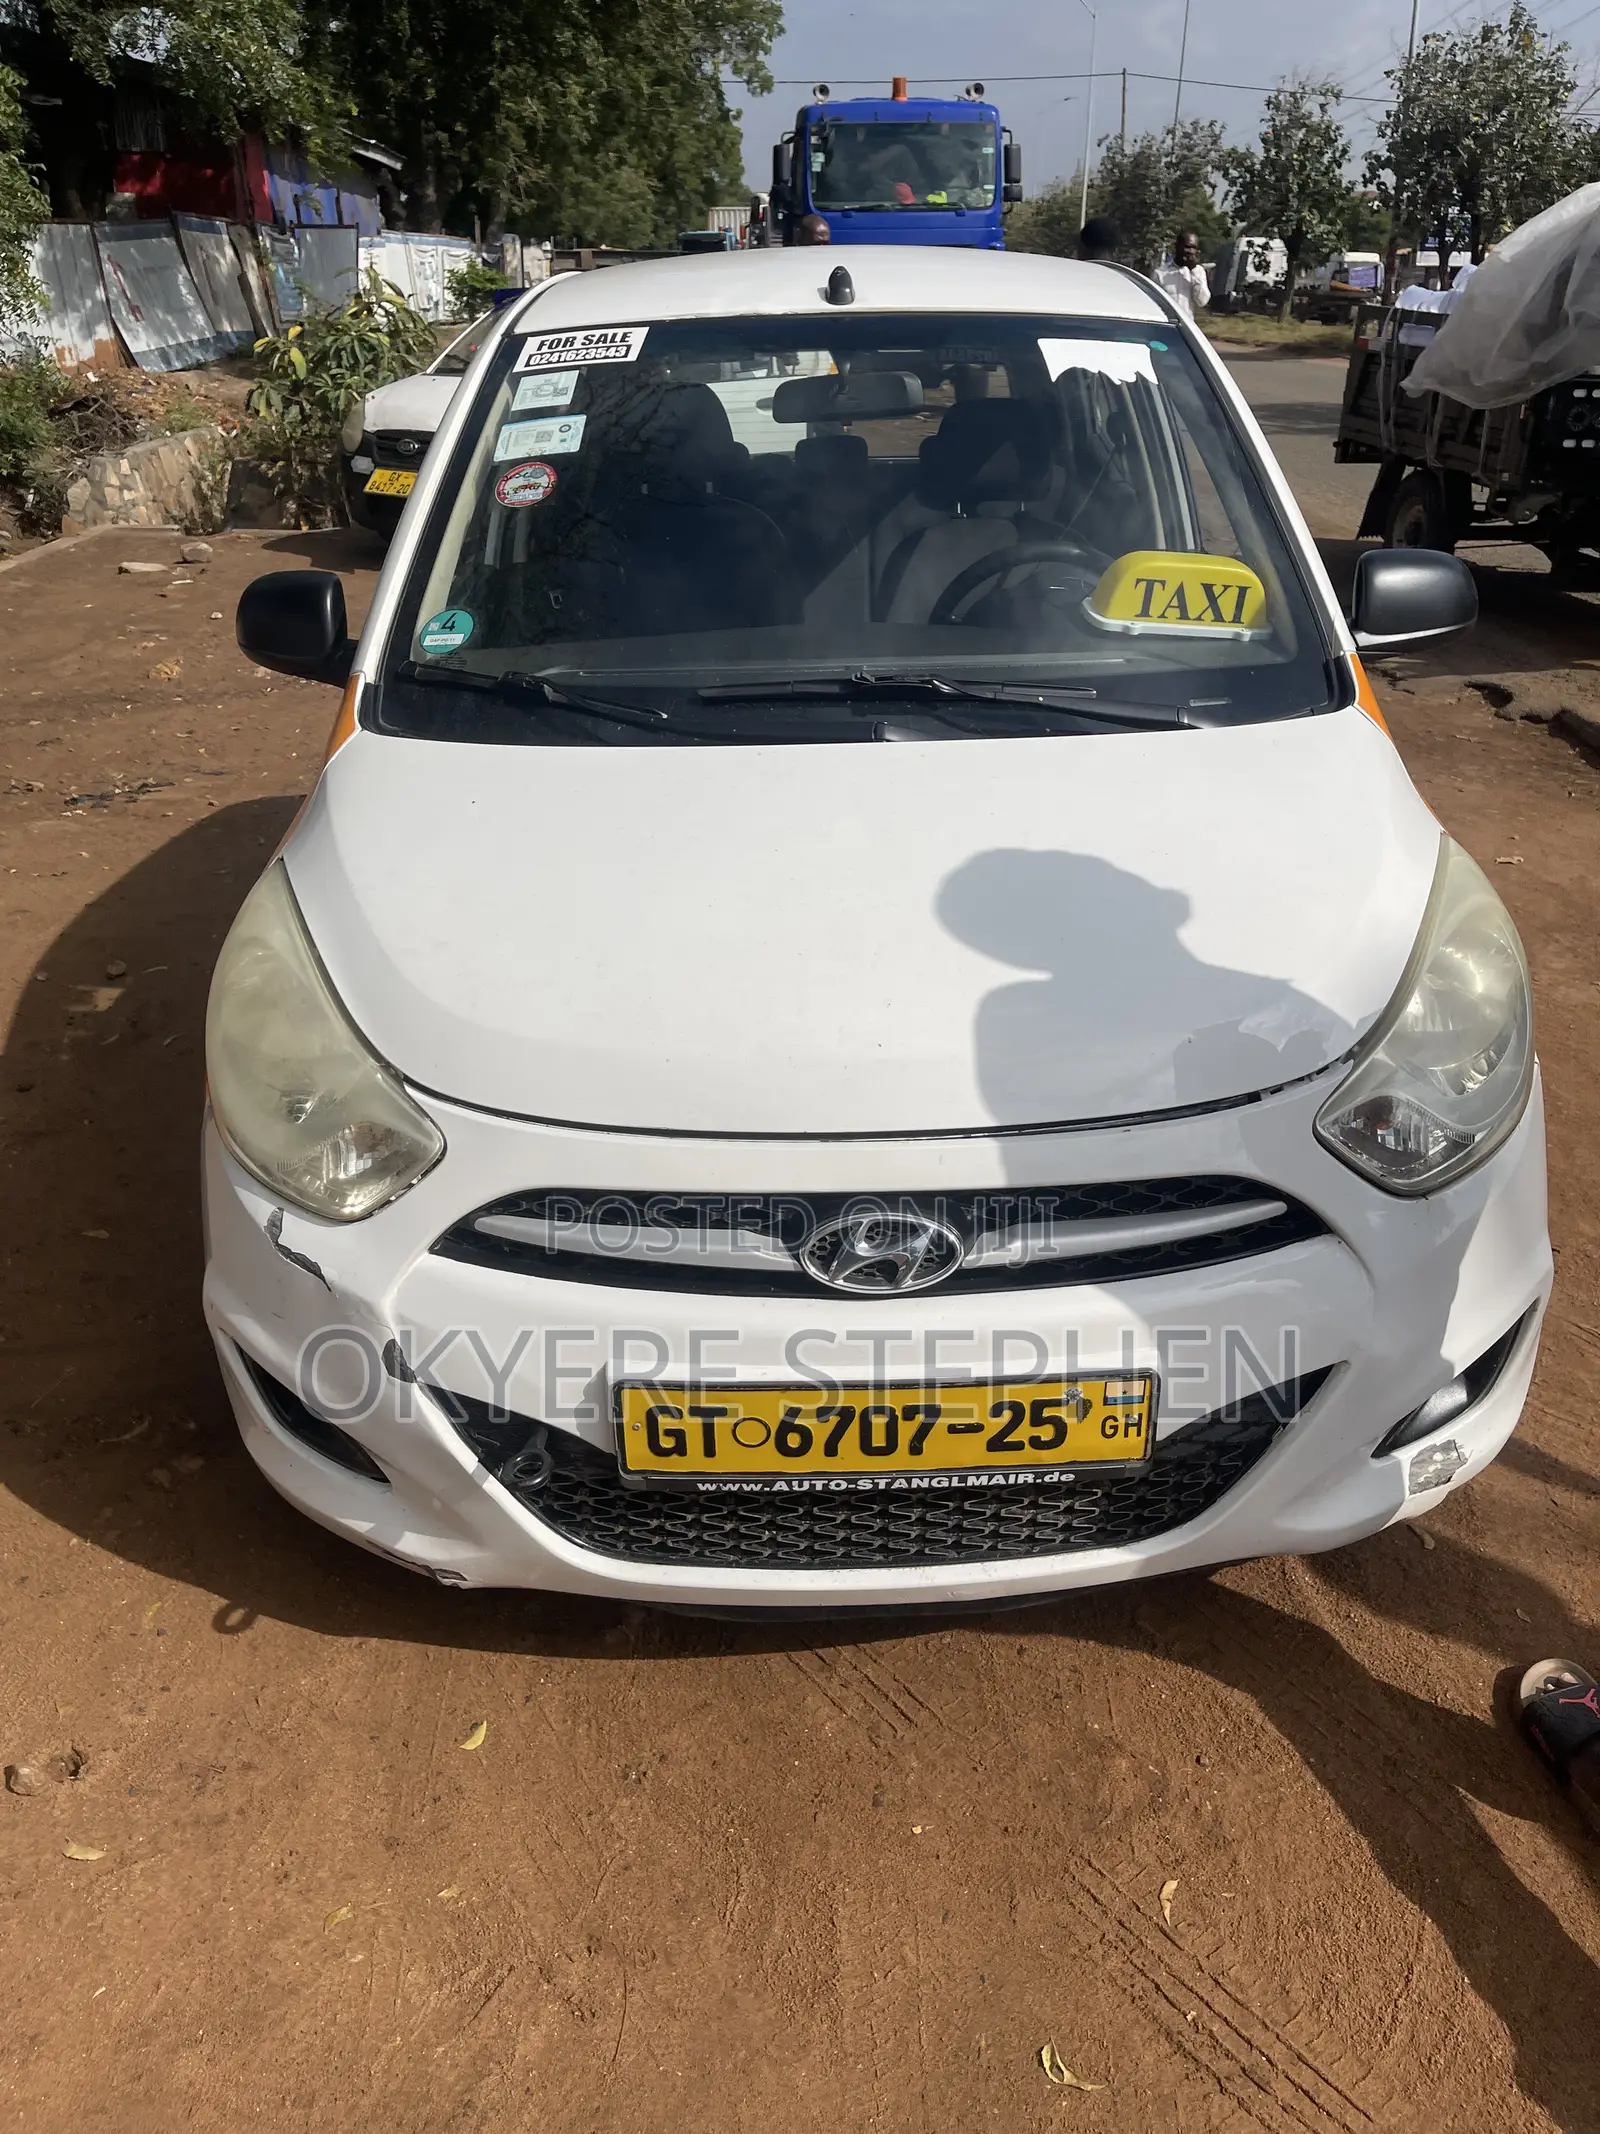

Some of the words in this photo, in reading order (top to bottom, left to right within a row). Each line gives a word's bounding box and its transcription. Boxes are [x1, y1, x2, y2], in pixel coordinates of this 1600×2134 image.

[536, 336, 577, 352] FOR
[580, 331, 633, 347] SALE
[529, 346, 628, 366] 0241623543
[1134, 578, 1252, 624] TAXI
[440, 612, 458, 631] 4
[645, 1404, 728, 1458] GT
[775, 1398, 1069, 1458] 6707-25
[1100, 1413, 1143, 1440] GH
[696, 1472, 1076, 1492] www.AUTO-STANGLMAIR.de
